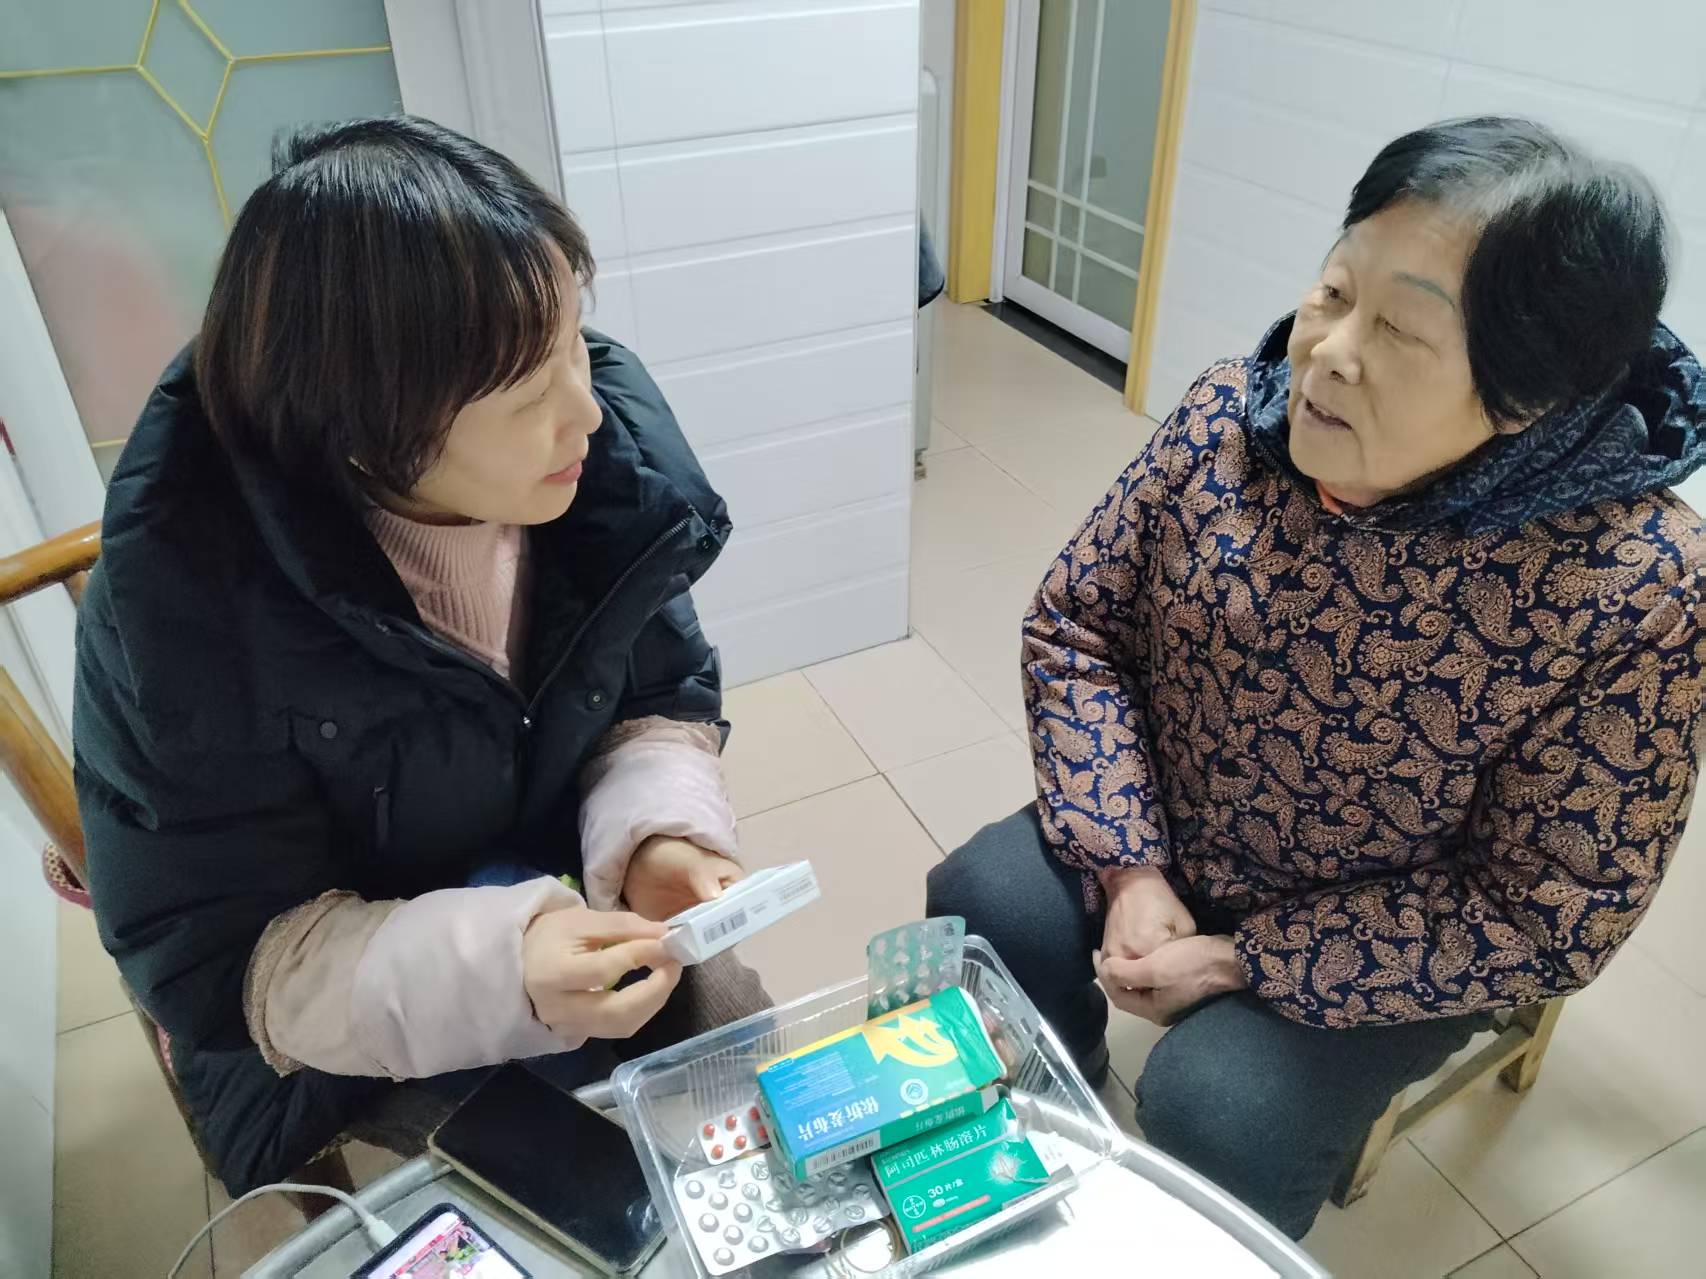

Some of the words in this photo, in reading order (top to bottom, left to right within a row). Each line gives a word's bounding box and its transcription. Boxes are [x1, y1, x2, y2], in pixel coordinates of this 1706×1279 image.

[797, 1095, 879, 1142] 依折麦布片
[884, 1124, 987, 1177] 阿司匹林肠溶片
